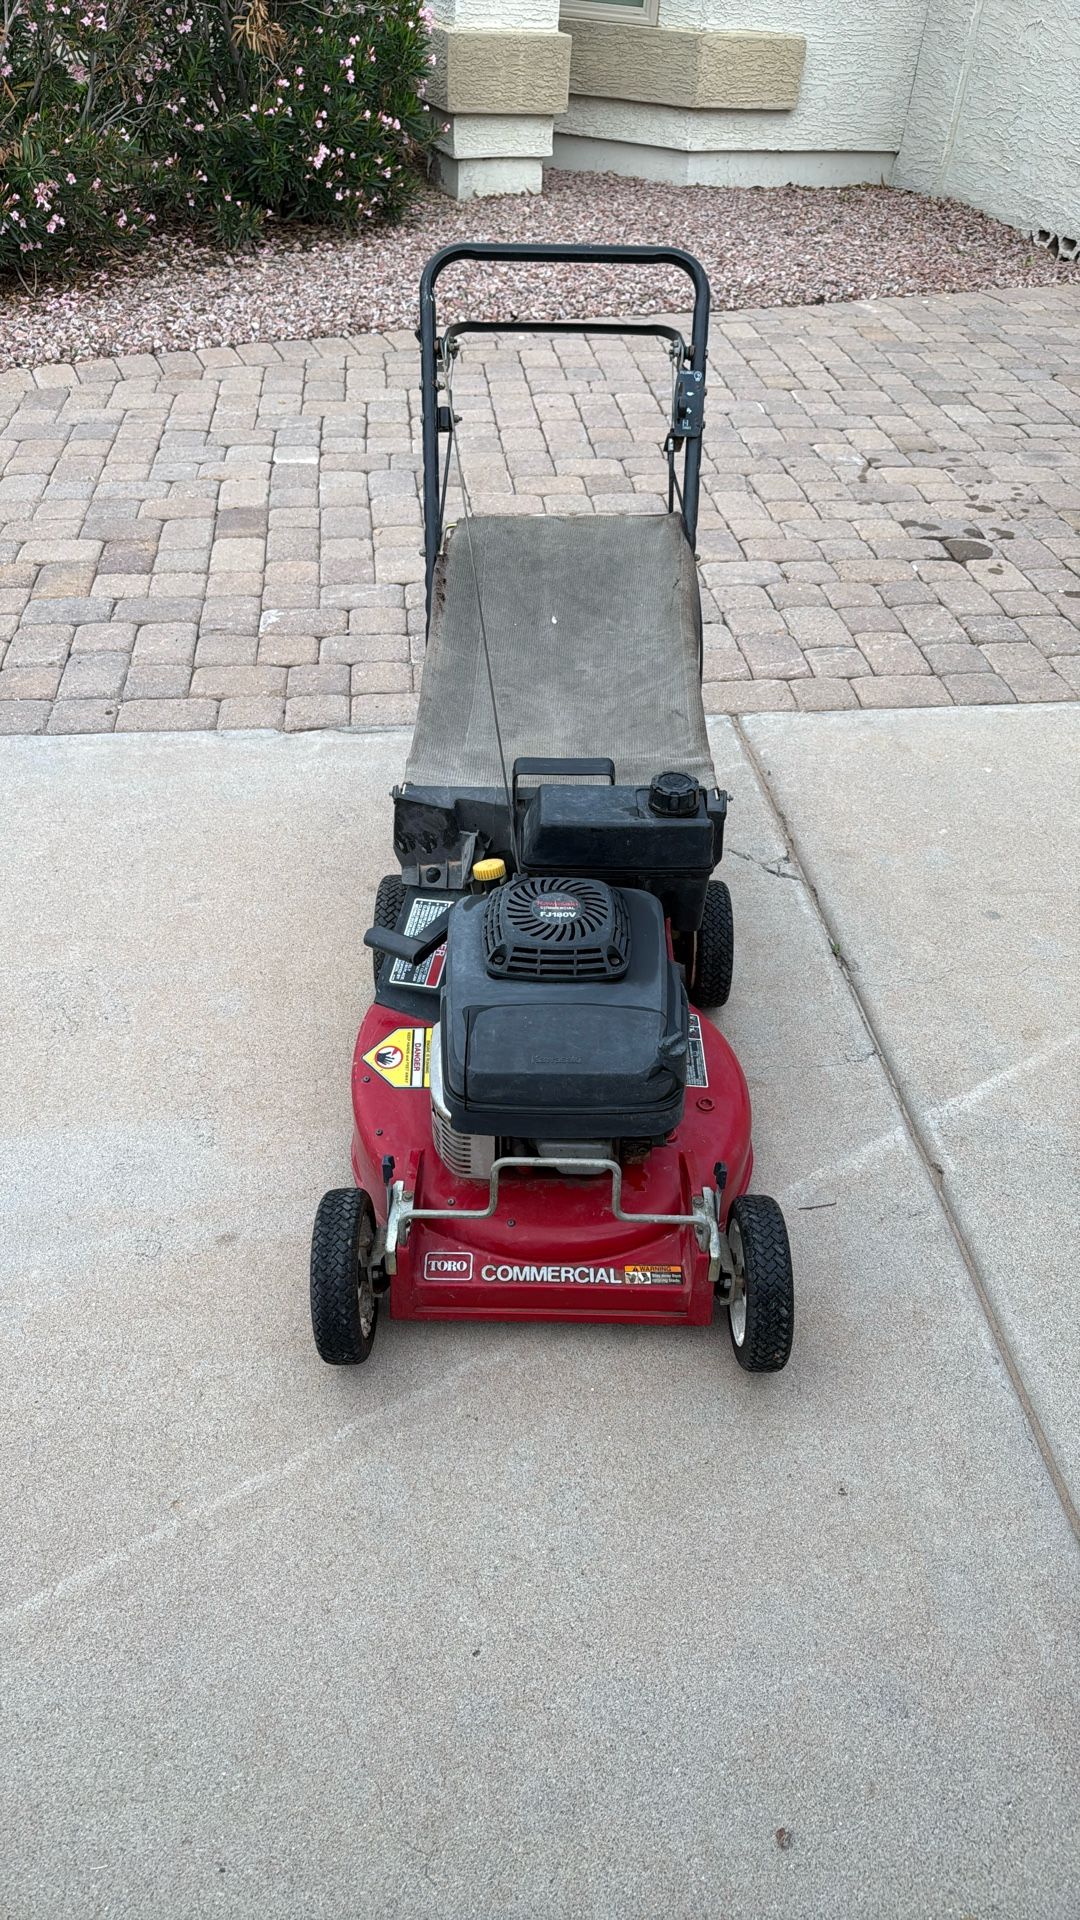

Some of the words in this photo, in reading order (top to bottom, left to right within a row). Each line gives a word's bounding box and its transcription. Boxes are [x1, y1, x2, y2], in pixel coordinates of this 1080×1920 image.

[414, 1043, 422, 1072] DANGER
[428, 1260, 467, 1272] TORO
[481, 1264, 622, 1284] COMMERCIAL
